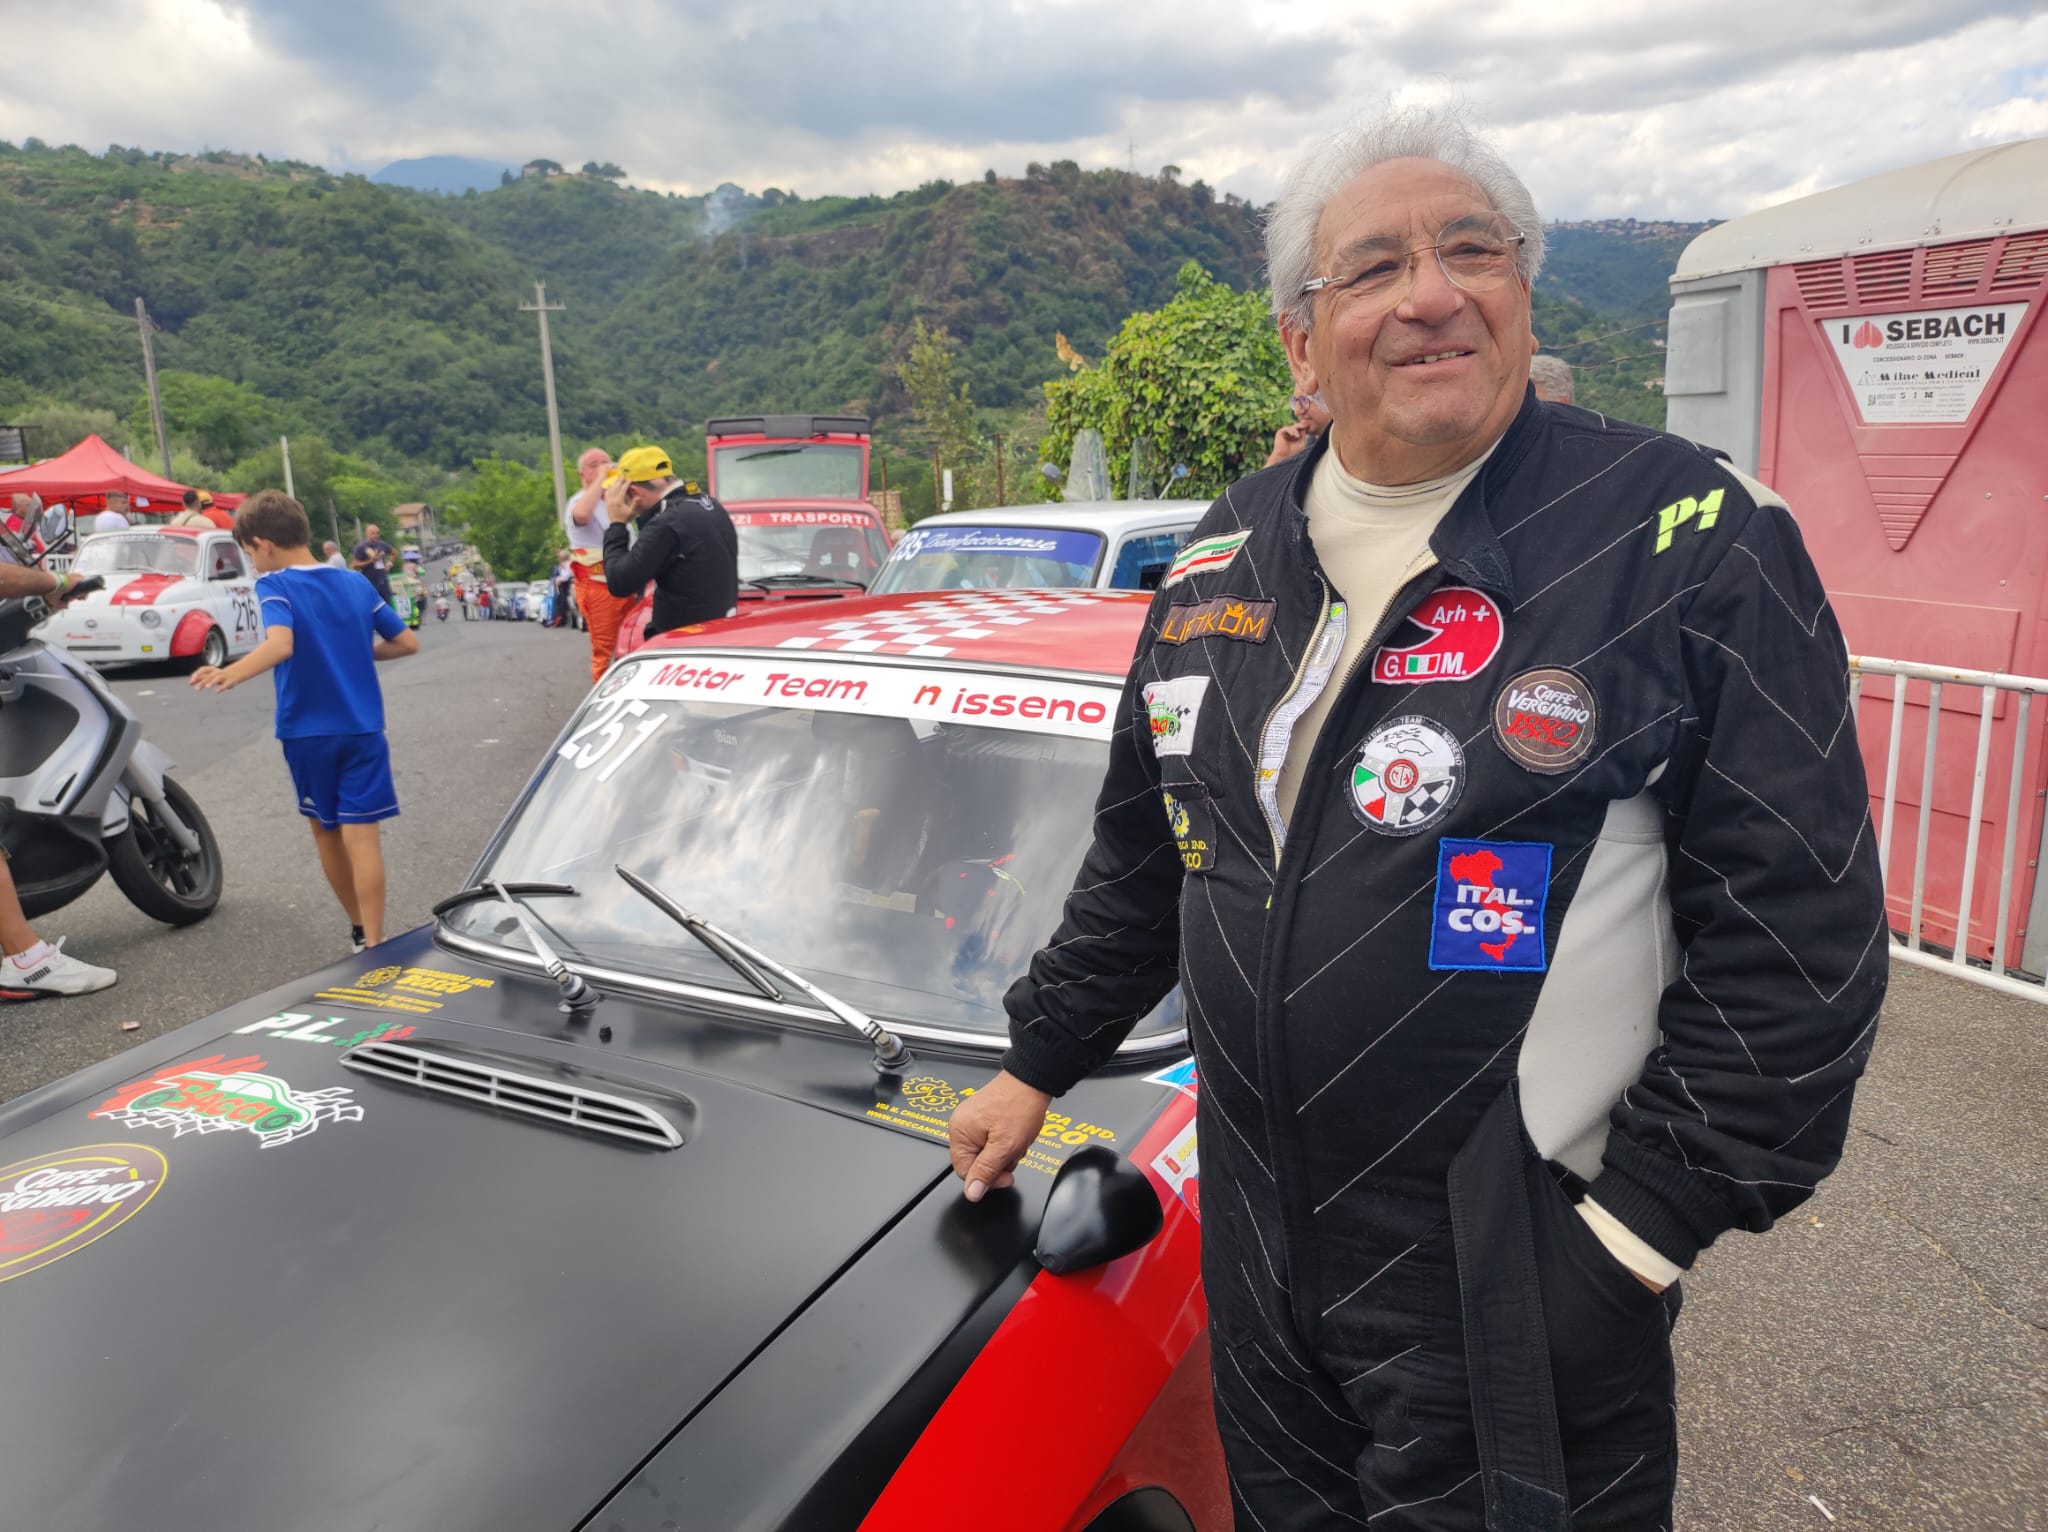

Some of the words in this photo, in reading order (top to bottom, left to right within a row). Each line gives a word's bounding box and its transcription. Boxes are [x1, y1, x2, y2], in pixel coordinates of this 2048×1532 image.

[1843, 324, 1849, 344] I
[1886, 312, 2006, 342] SEBACH
[769, 512, 869, 526] TRASPORTI
[232, 597, 258, 632] 216
[1431, 604, 1467, 625] Arh
[649, 663, 745, 691] Motor
[763, 673, 869, 701] Team
[1400, 716, 1423, 725] TEAM
[1501, 711, 1579, 747] 1882
[557, 699, 669, 783] 251
[1456, 884, 1534, 906] ITAL.
[1448, 908, 1536, 935] COS.
[23, 966, 52, 984] PUMA
[1074, 1122, 1116, 1142] IND.
